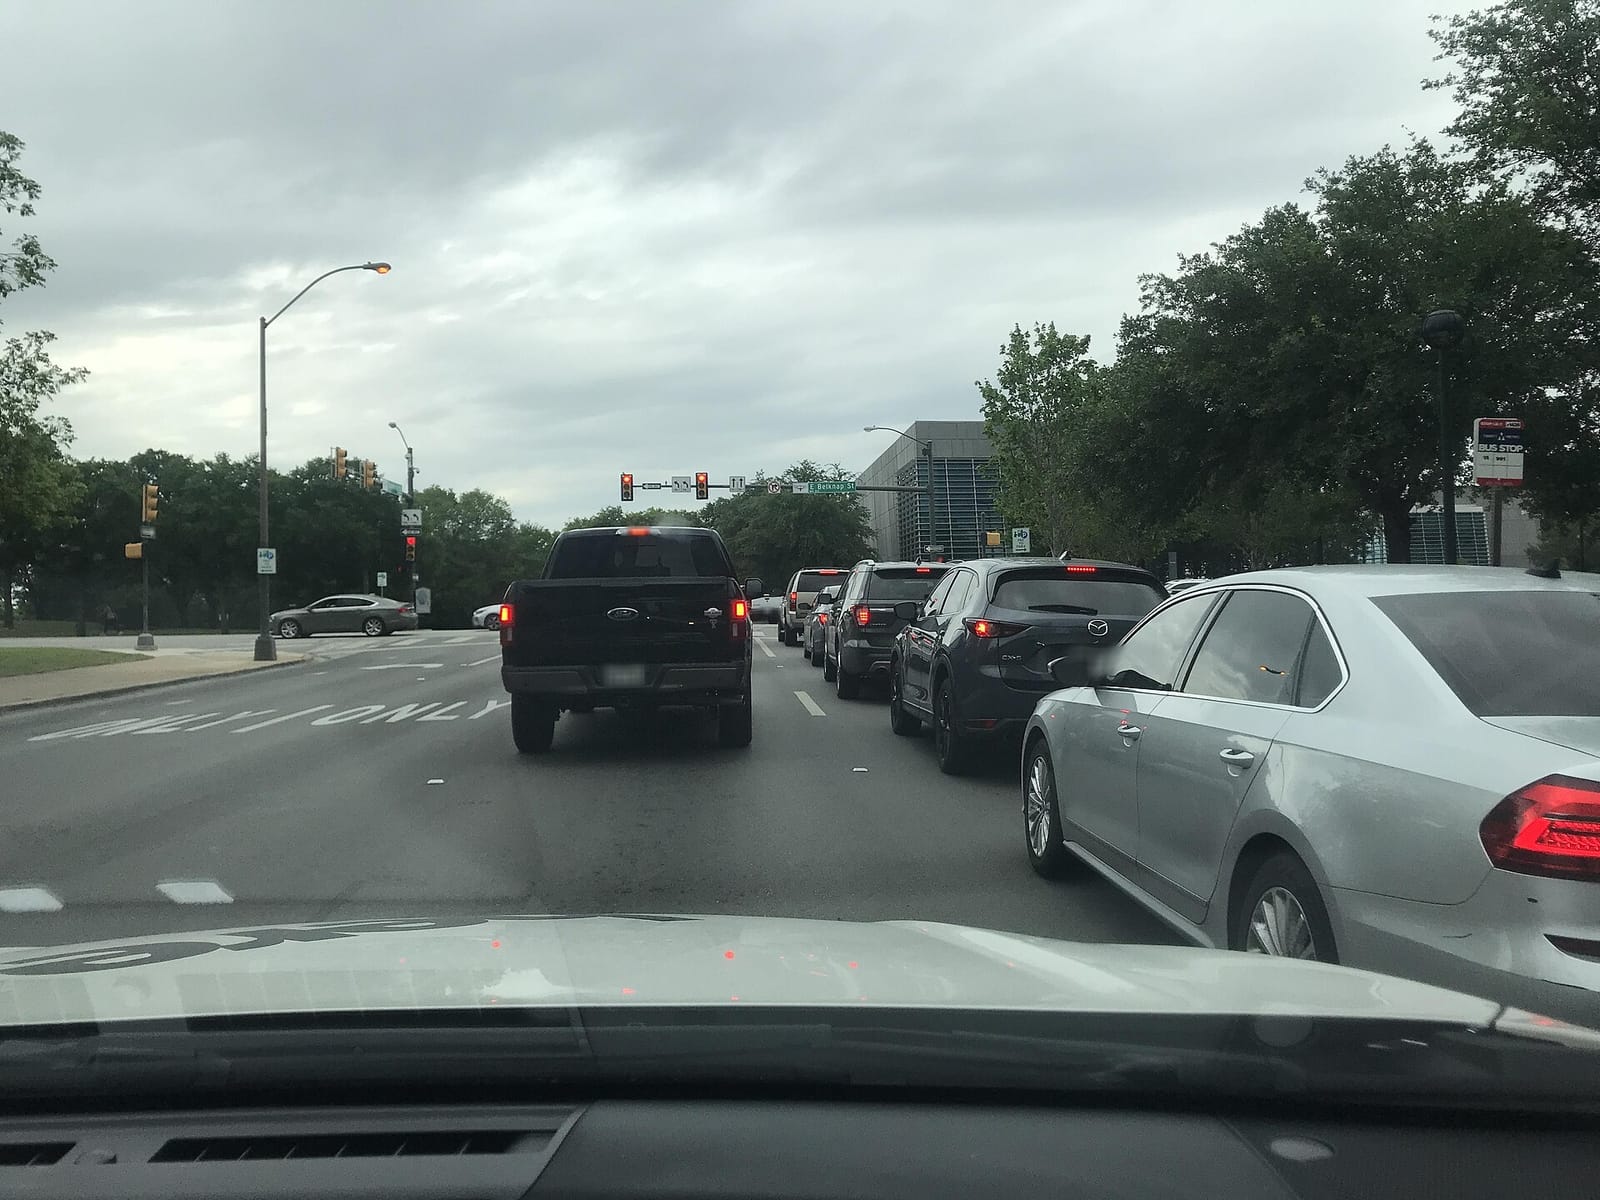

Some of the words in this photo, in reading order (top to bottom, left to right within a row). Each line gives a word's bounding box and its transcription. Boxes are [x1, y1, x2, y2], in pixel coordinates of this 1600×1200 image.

[1479, 443, 1498, 451] BUS
[1499, 444, 1523, 452] STOP
[311, 700, 512, 726] ONLY
